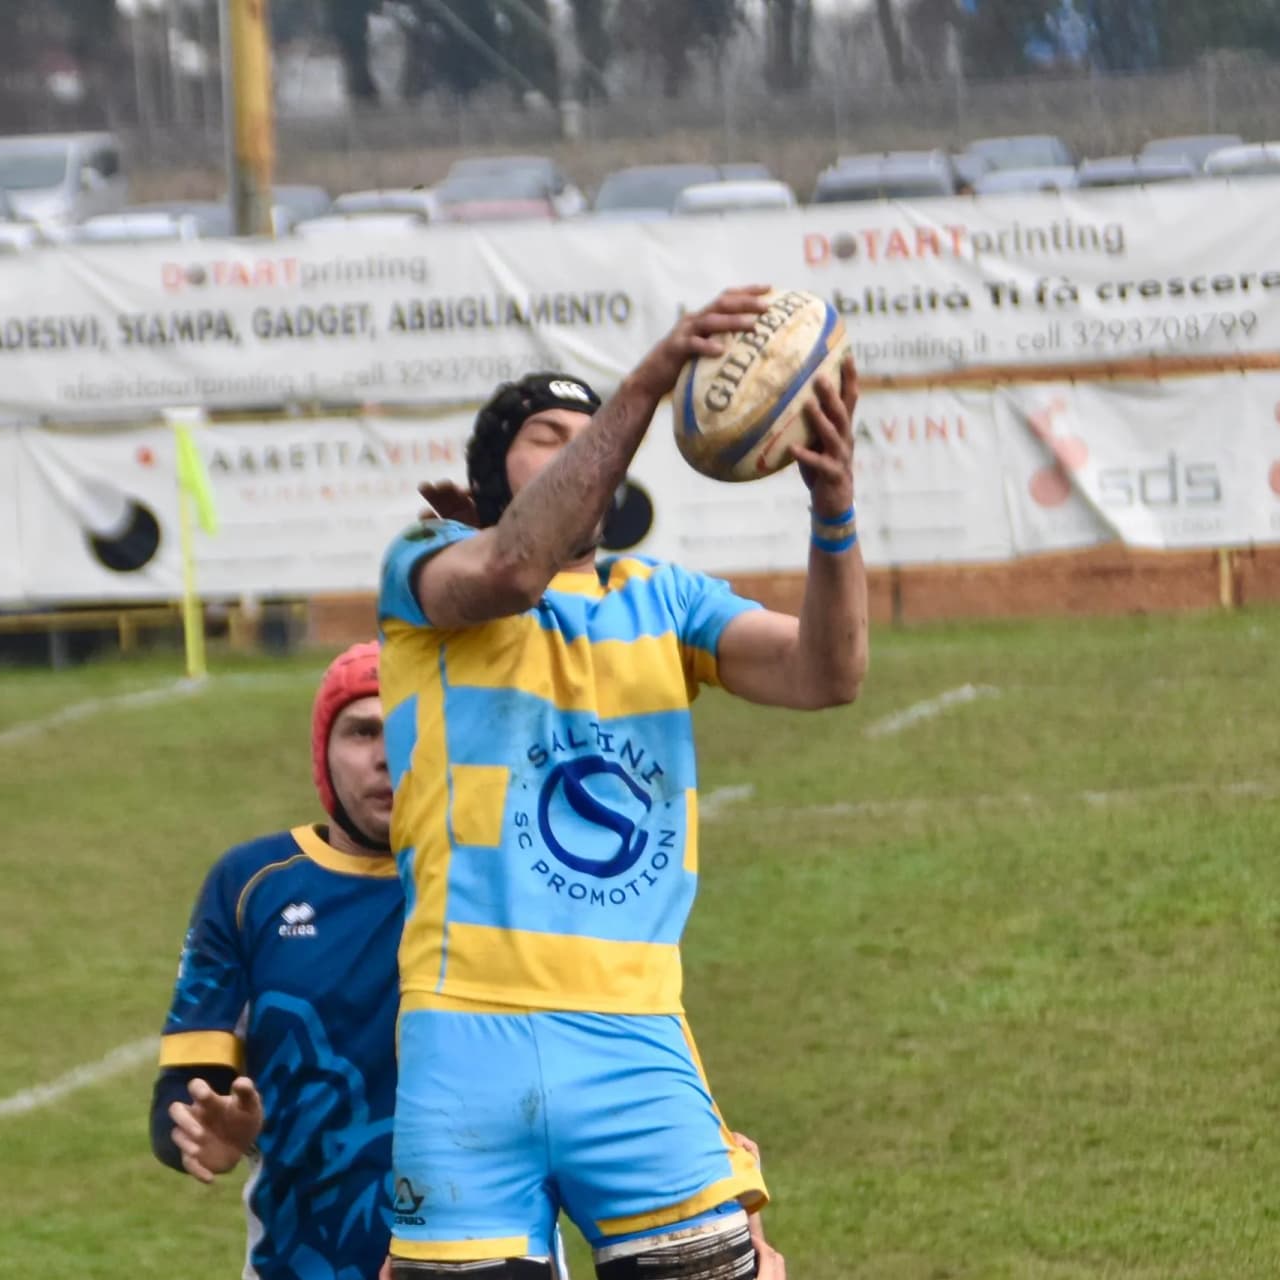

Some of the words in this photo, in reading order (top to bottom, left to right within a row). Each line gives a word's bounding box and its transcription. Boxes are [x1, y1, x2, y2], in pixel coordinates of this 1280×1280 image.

[120, 304, 242, 349] STAMPA,
[252, 300, 378, 342] GADGET,
[388, 290, 632, 333] ABBIGLIAMENTO
[984, 276, 1020, 307] Ti
[1016, 322, 1062, 353] cell
[1073, 309, 1260, 347] 3293708799
[1097, 450, 1221, 507] sds
[526, 721, 664, 787] SALTINI
[515, 811, 533, 850] SC
[530, 828, 677, 907] PROMOTION
